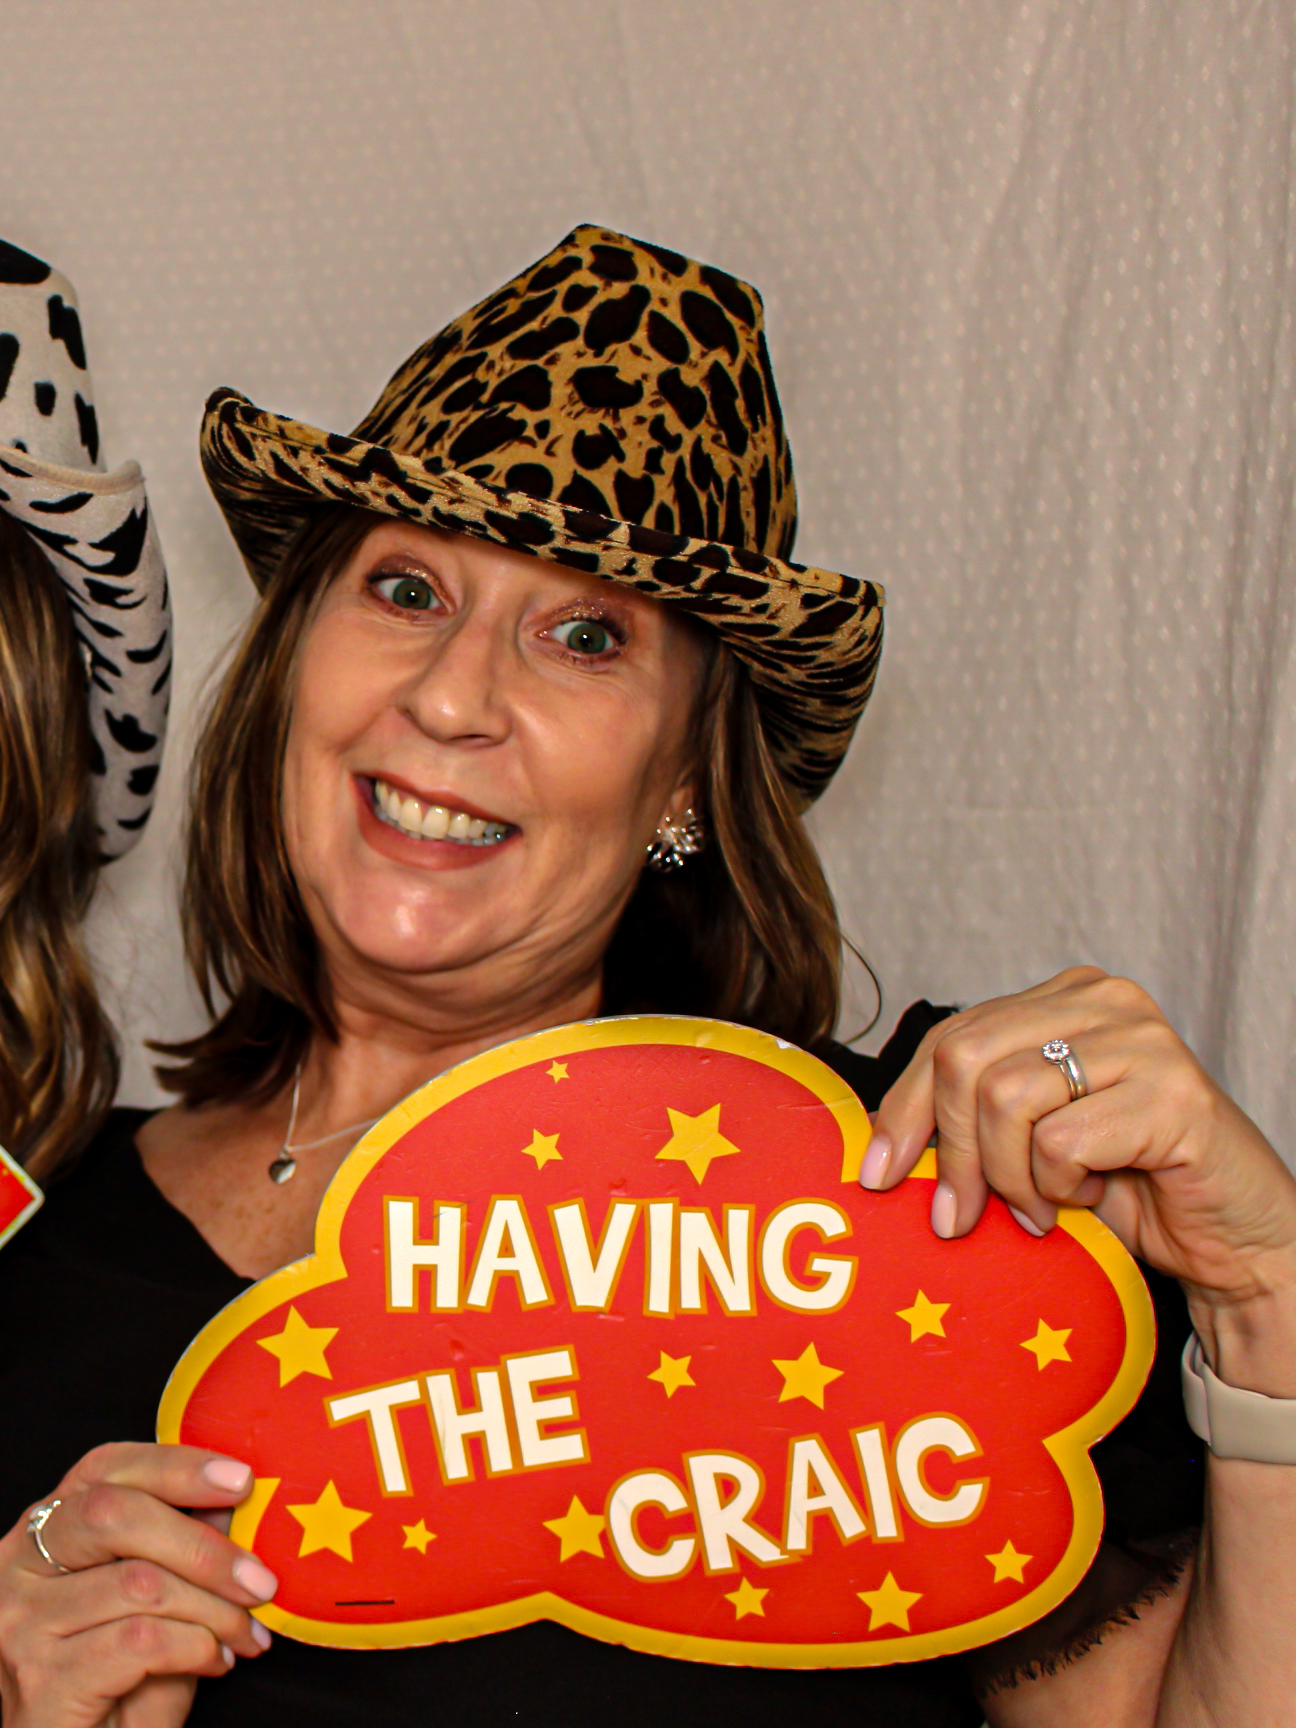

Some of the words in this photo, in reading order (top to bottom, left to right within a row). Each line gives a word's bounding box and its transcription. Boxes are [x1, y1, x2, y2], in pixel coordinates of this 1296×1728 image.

[384, 1195, 858, 1317] HAVING
[325, 1344, 590, 1498] THE
[606, 1411, 990, 1583] CRAIC
